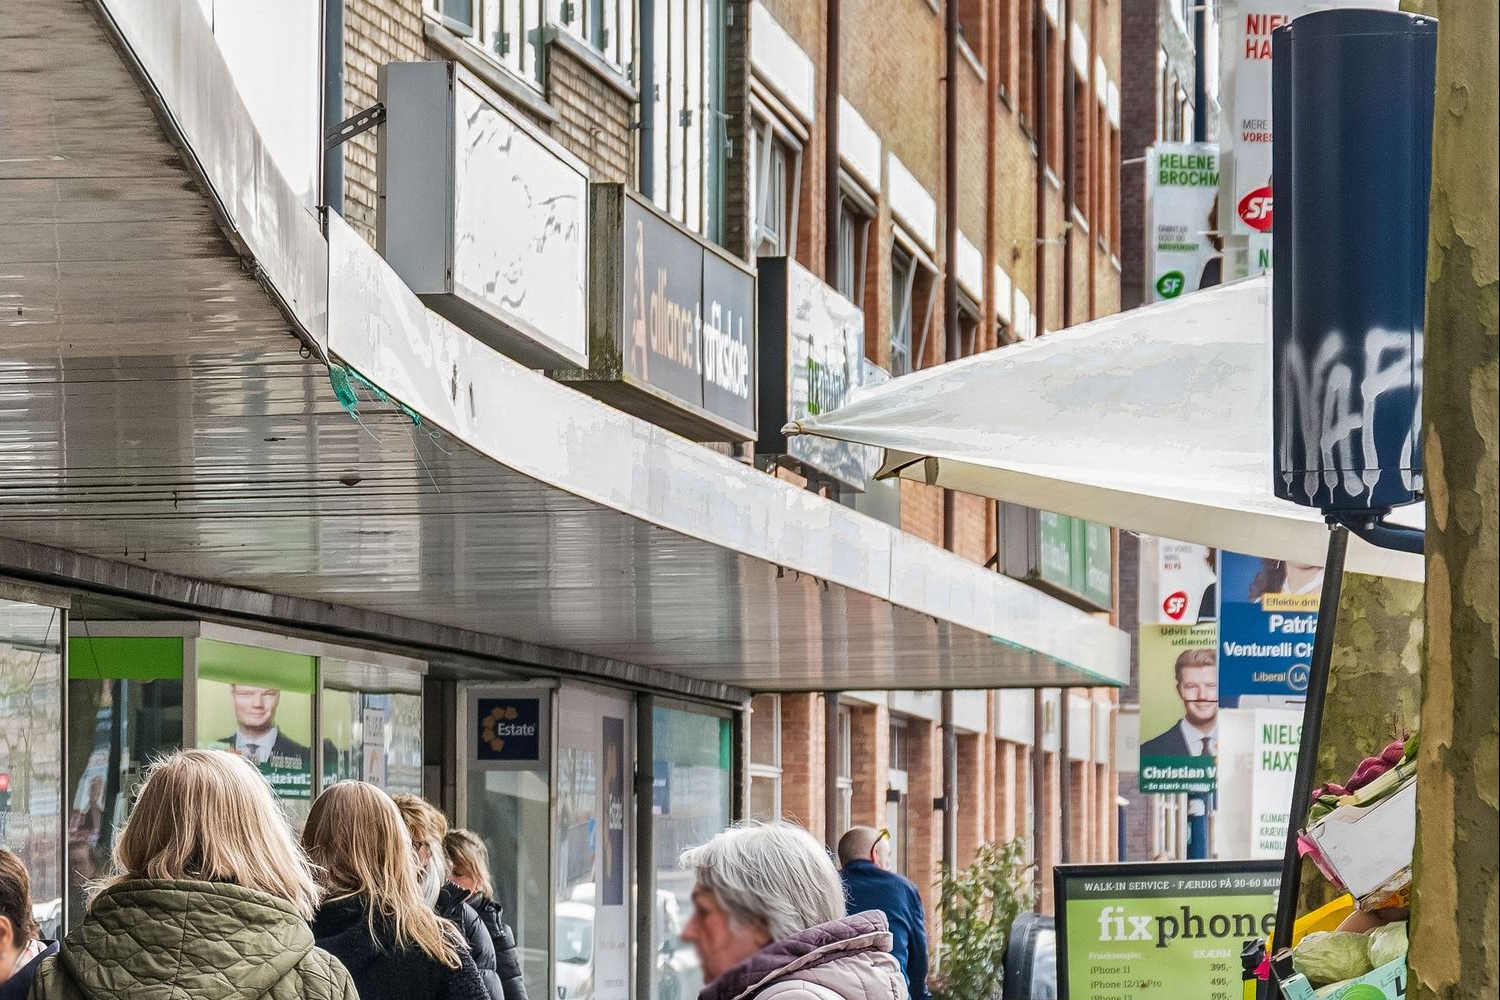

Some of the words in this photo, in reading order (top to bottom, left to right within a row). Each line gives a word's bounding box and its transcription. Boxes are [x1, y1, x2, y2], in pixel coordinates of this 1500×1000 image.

[1243, 119, 1268, 129] MERE
[1160, 154, 1215, 170] HELENE
[1247, 197, 1273, 219] SF
[1161, 278, 1180, 293] SF
[1167, 597, 1185, 614] SF
[1266, 598, 1299, 607] Effektiv
[1161, 628, 1187, 636] Udvis
[1223, 641, 1292, 657] Venturelli
[1253, 672, 1286, 682] Liberal
[1293, 673, 1307, 682] LA
[497, 723, 535, 736] Estate
[1143, 767, 1205, 779] Christian
[1260, 826, 1288, 836] KRÆVE
[1085, 882, 1126, 891] WALK-IN
[1129, 881, 1170, 890] SERVICE
[1178, 880, 1217, 890] FÆRDIG
[1219, 878, 1232, 888] PÅ
[1234, 878, 1261, 888] 30-60
[1192, 949, 1232, 959] SKÆRM
[1090, 965, 1122, 974] iPhone
[1124, 966, 1131, 974] 11
[1210, 964, 1233, 973] 395,-
[1090, 980, 1122, 989] iPhone
[1147, 979, 1163, 988] Pro
[1210, 978, 1233, 987] 495,-
